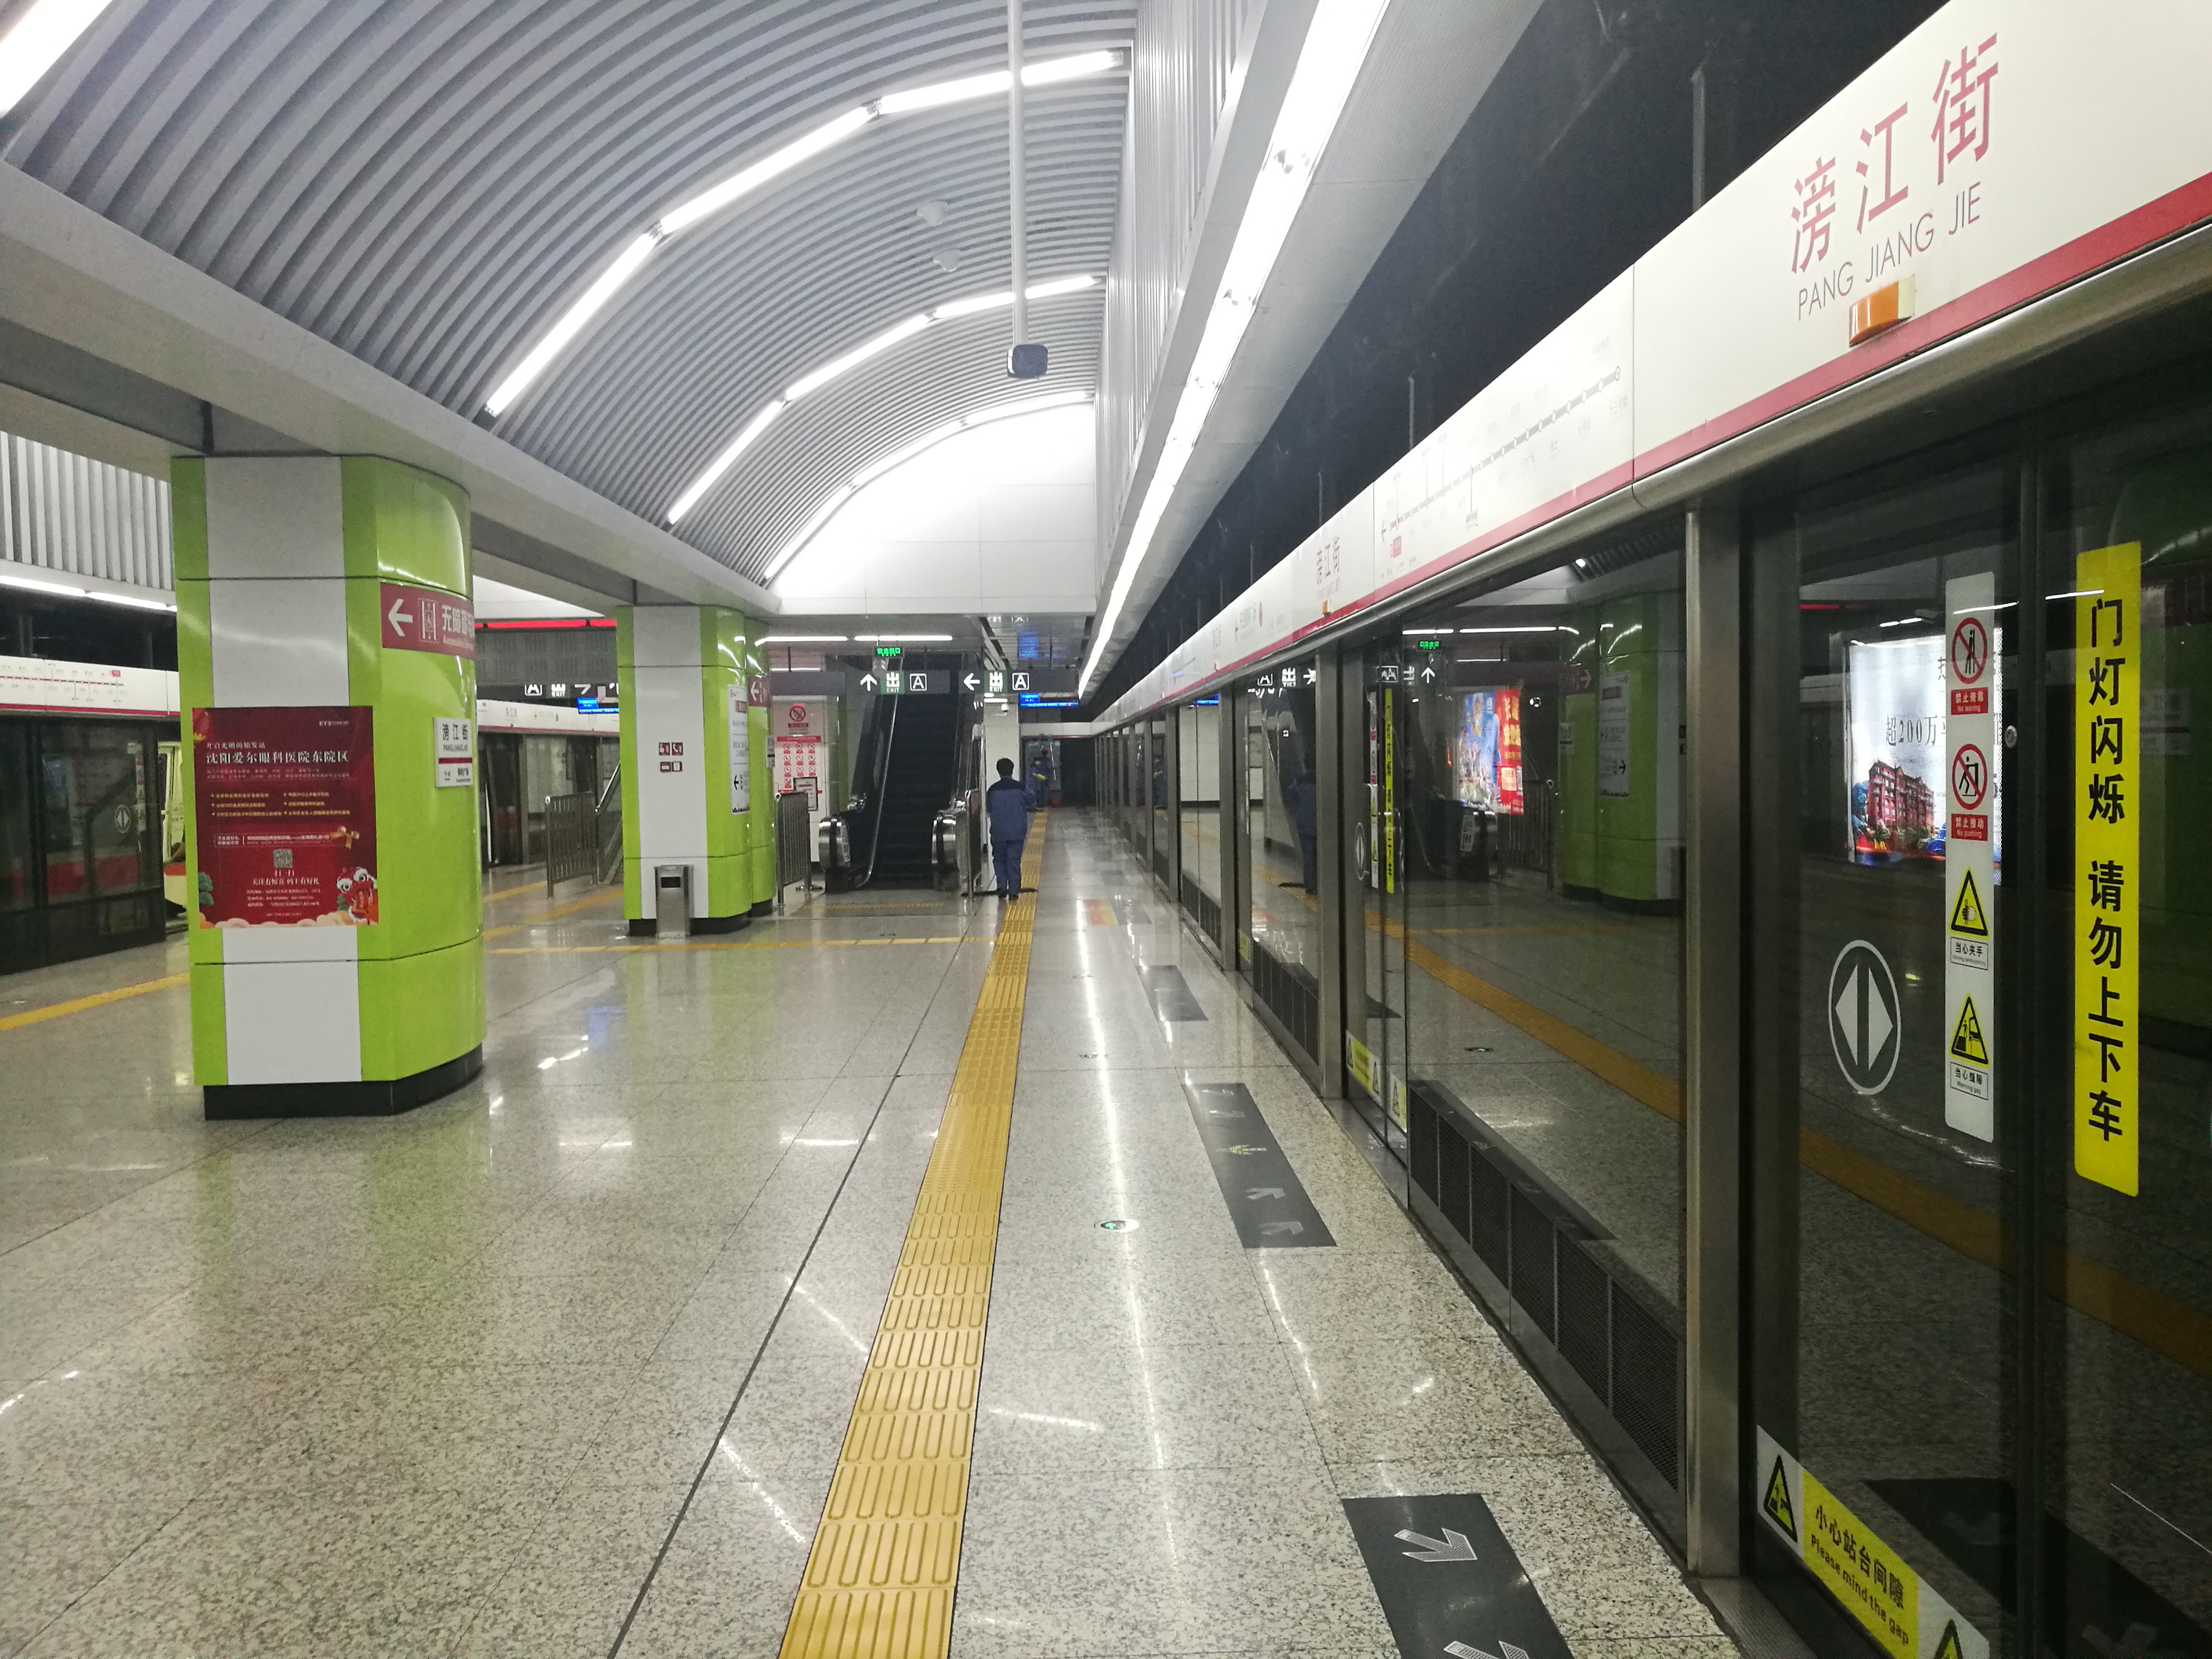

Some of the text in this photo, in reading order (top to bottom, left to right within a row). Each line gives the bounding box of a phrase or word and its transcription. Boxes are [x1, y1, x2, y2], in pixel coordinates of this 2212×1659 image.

[1791, 32, 1998, 274] 滂江街
[1798, 181, 1981, 321] PANG JIANG JIE
[886, 672, 900, 687] 出
[913, 676, 925, 689] A
[989, 672, 1003, 687] 出
[1015, 675, 1027, 688] A
[1956, 691, 1984, 704] 禁止倚靠
[206, 750, 348, 764] 沈阳爱尔眼科医院东院区
[1956, 817, 1984, 830] 禁止推动
[2088, 598, 2126, 1142] 门灯闪烁 请勿上下车
[1956, 942, 1983, 957] 当心夹手
[1816, 1505, 1904, 1609] 小心站台间隙
[1811, 1534, 1909, 1646] Please mind the gap
